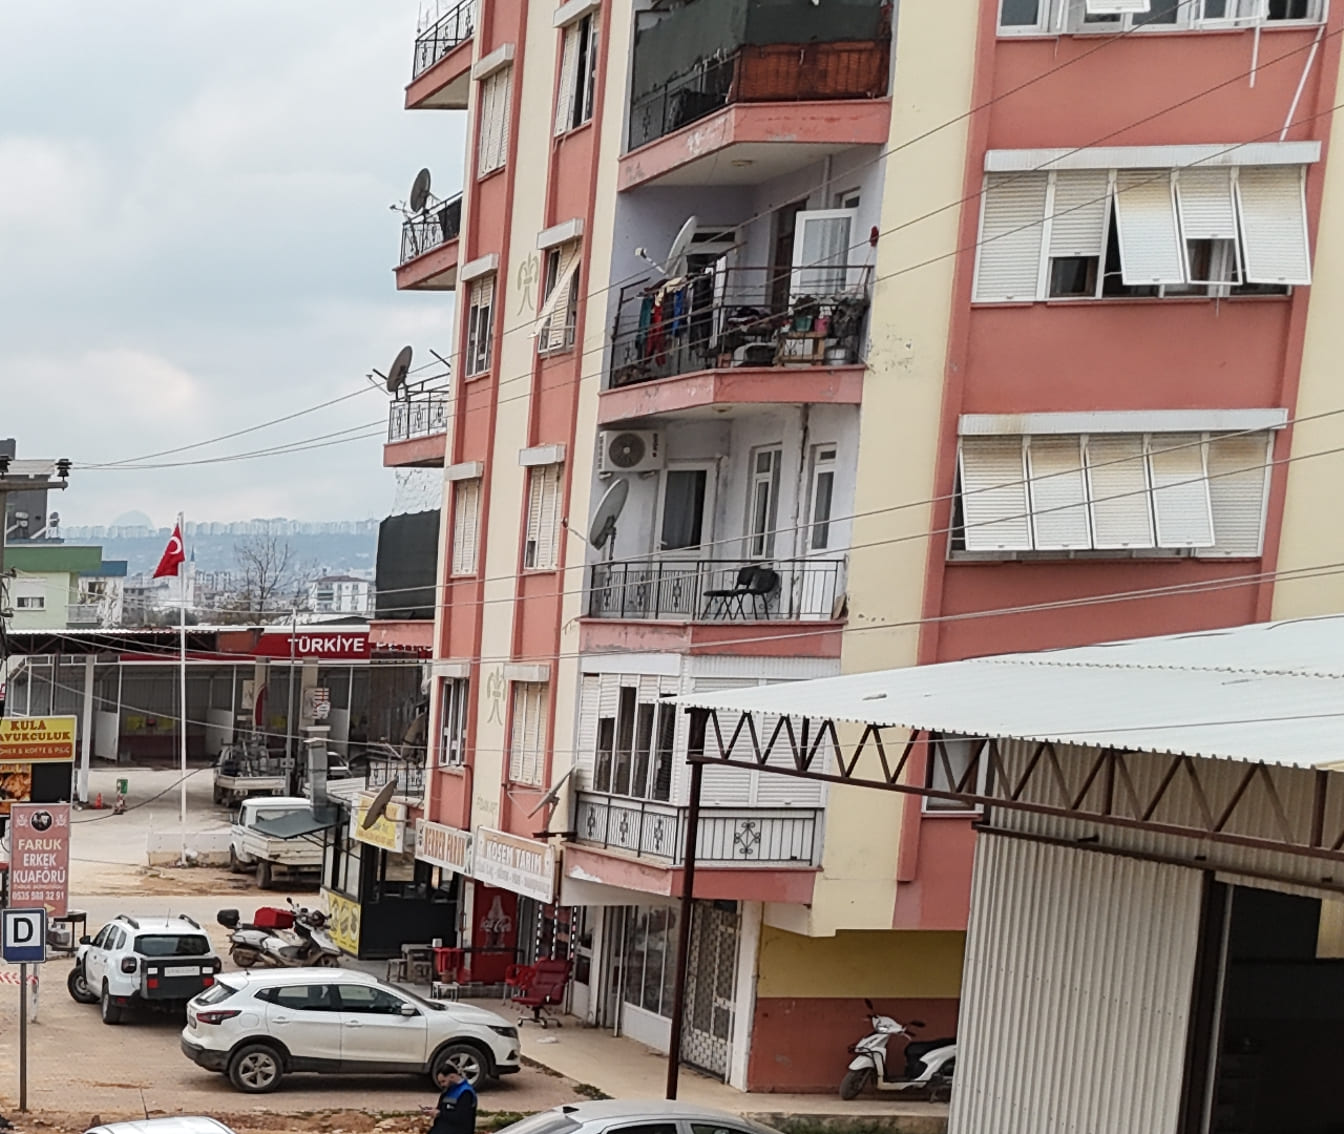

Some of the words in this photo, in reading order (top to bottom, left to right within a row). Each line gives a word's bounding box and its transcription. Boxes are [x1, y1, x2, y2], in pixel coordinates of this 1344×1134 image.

[288, 634, 365, 652] TÜRKİYE
[11, 720, 47, 731] KULA
[18, 839, 62, 850] FARUK
[23, 853, 57, 867] ERKEK
[13, 866, 66, 883] KUAFÖRÜ
[13, 917, 34, 943] D
